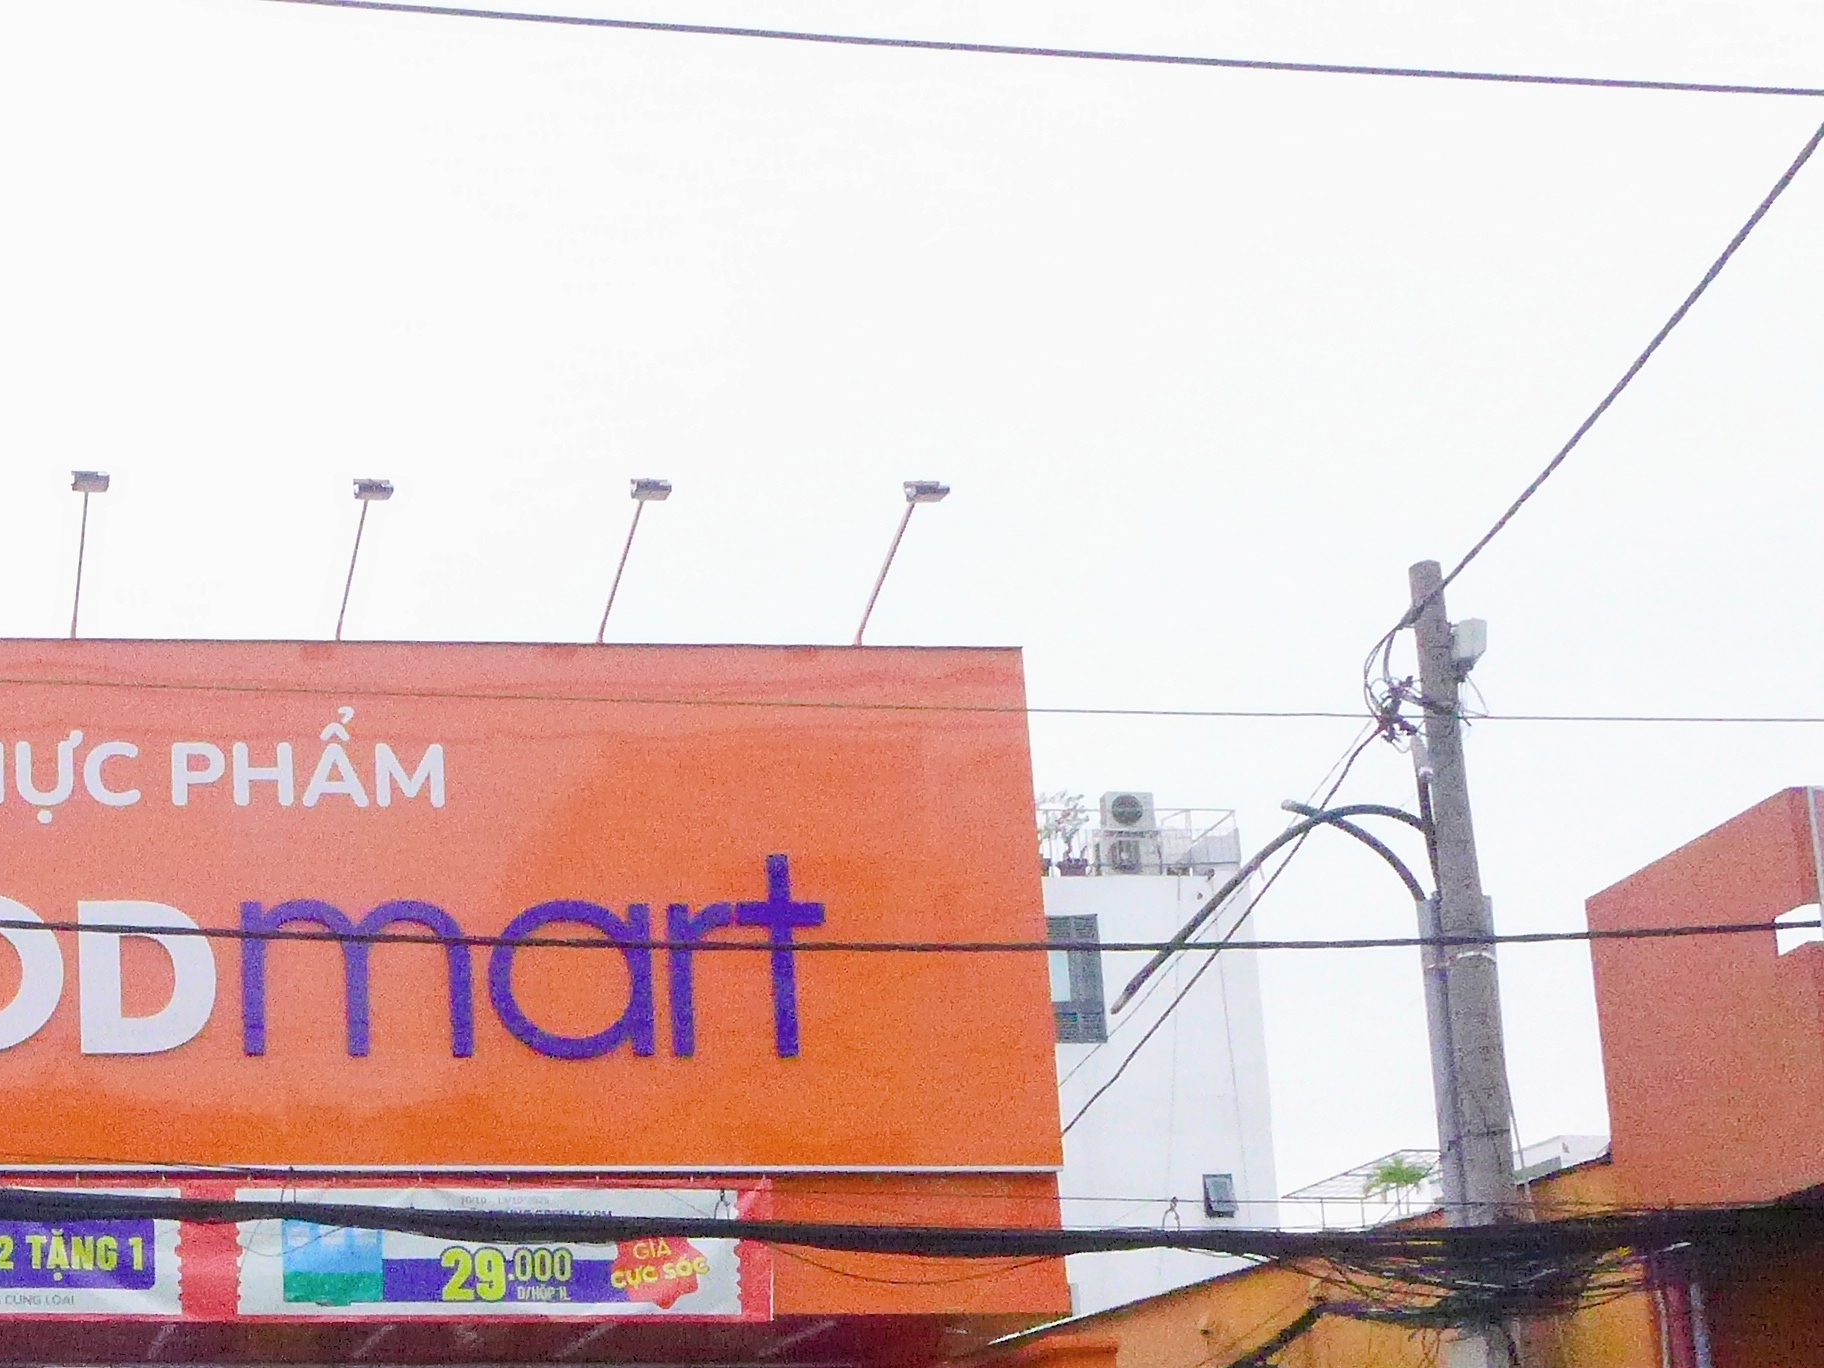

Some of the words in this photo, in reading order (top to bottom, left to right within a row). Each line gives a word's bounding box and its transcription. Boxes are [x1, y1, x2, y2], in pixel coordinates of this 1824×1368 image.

[170, 705, 447, 809] PHẨM
[25, 1228, 121, 1282] TẶNG
[128, 1236, 144, 1272] 1
